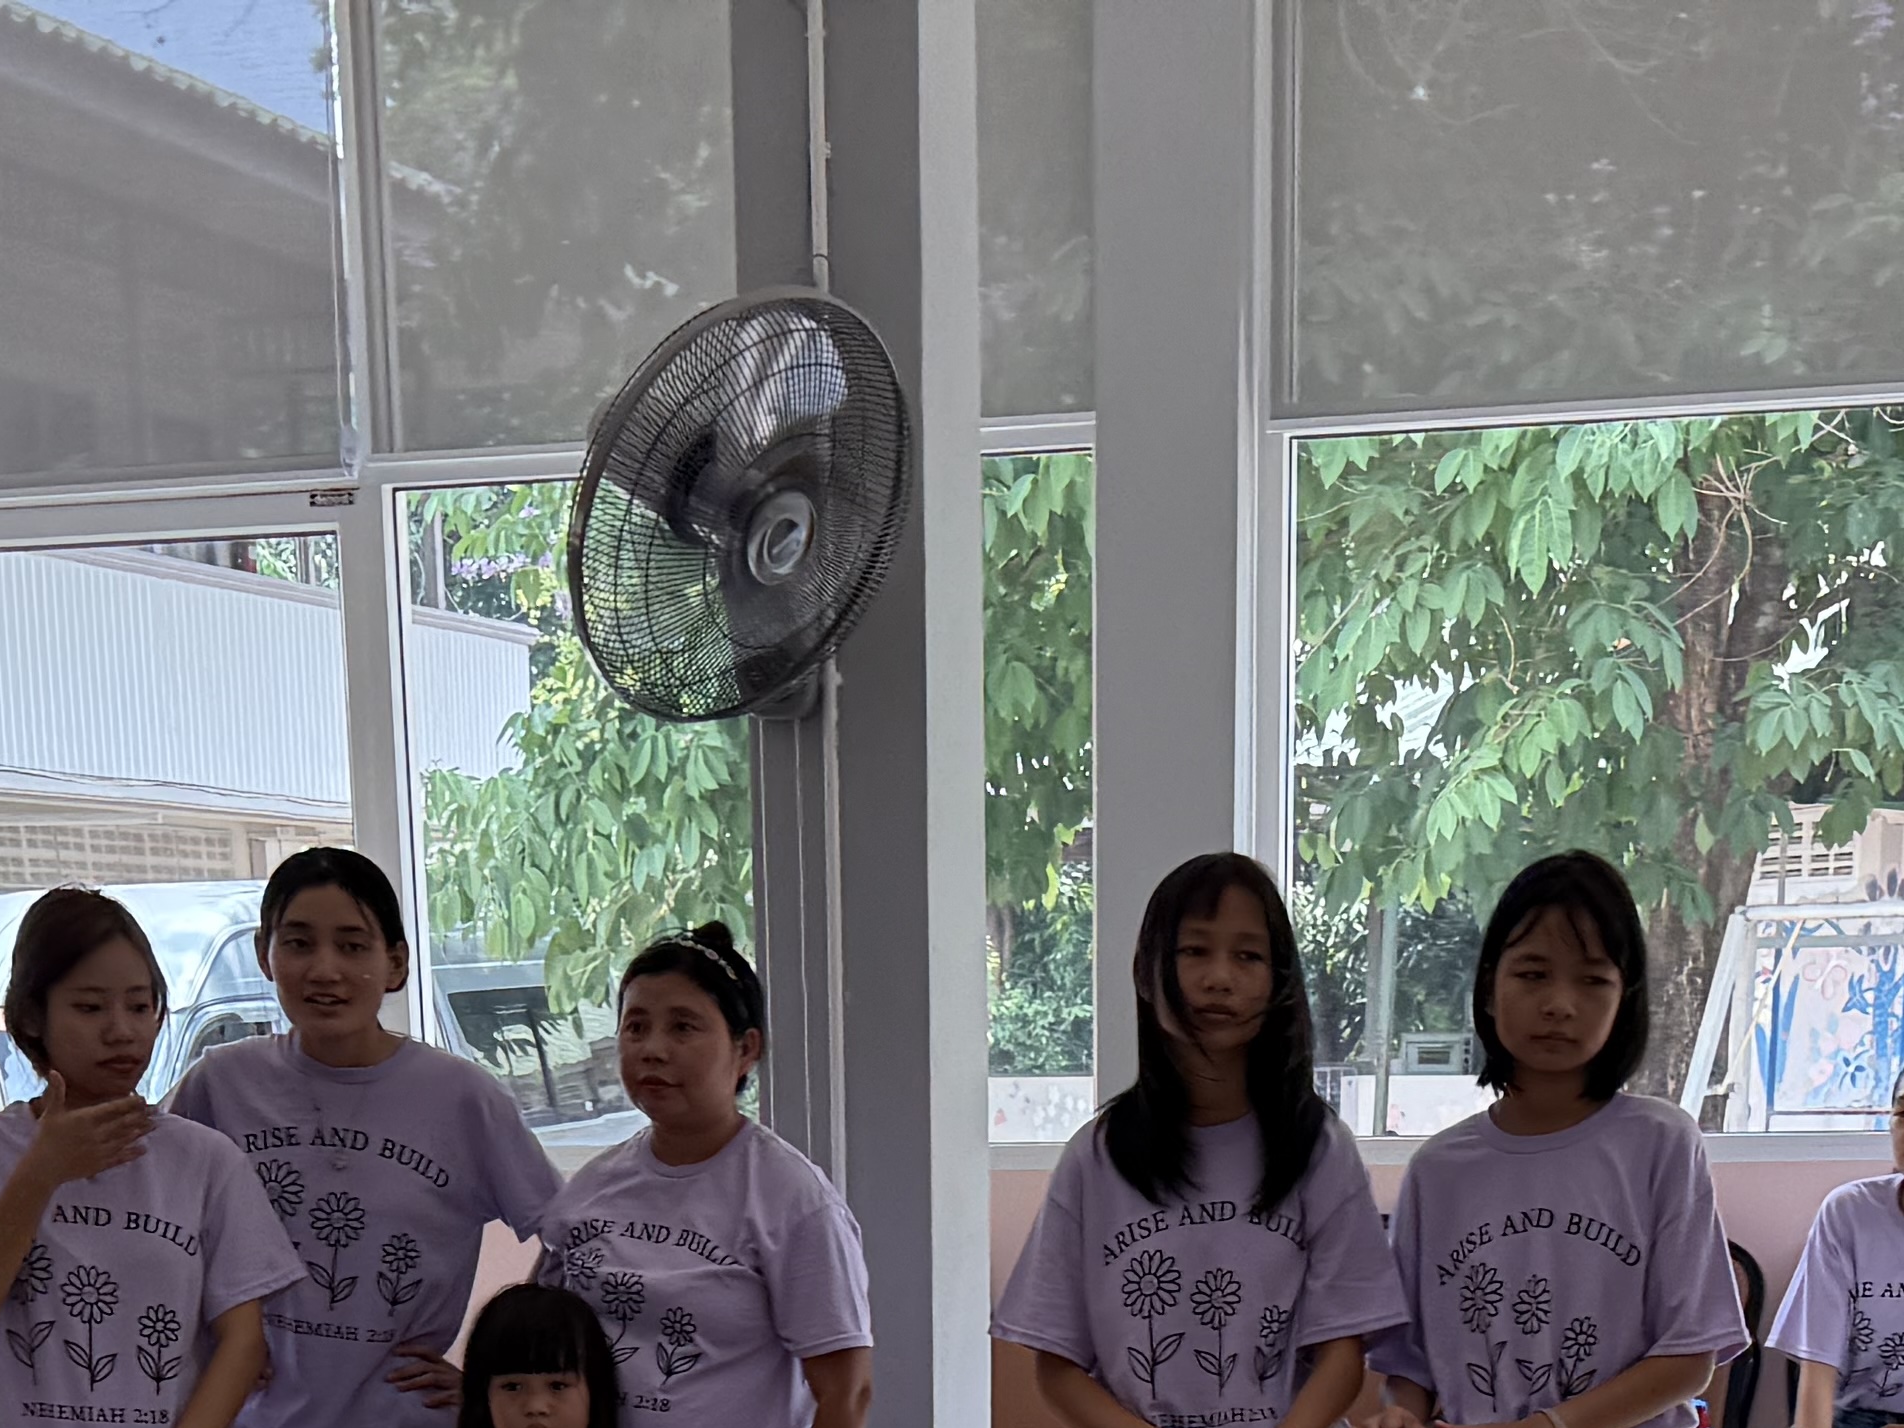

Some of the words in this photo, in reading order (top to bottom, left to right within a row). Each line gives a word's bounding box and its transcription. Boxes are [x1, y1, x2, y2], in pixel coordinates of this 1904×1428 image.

[243, 1127, 302, 1154] RISE
[310, 1127, 370, 1152] AND
[378, 1138, 450, 1190] BUILD
[53, 1204, 112, 1227] AND
[621, 1222, 670, 1244] AND
[1102, 1209, 1170, 1266] ARISE
[1178, 1200, 1238, 1228] AND
[1436, 1222, 1495, 1288] ARISE
[1501, 1208, 1555, 1237] AND
[1564, 1213, 1642, 1268] BUILD
[22, 1401, 126, 1424] NEHEMIAH
[133, 1408, 170, 1425] 2:18
